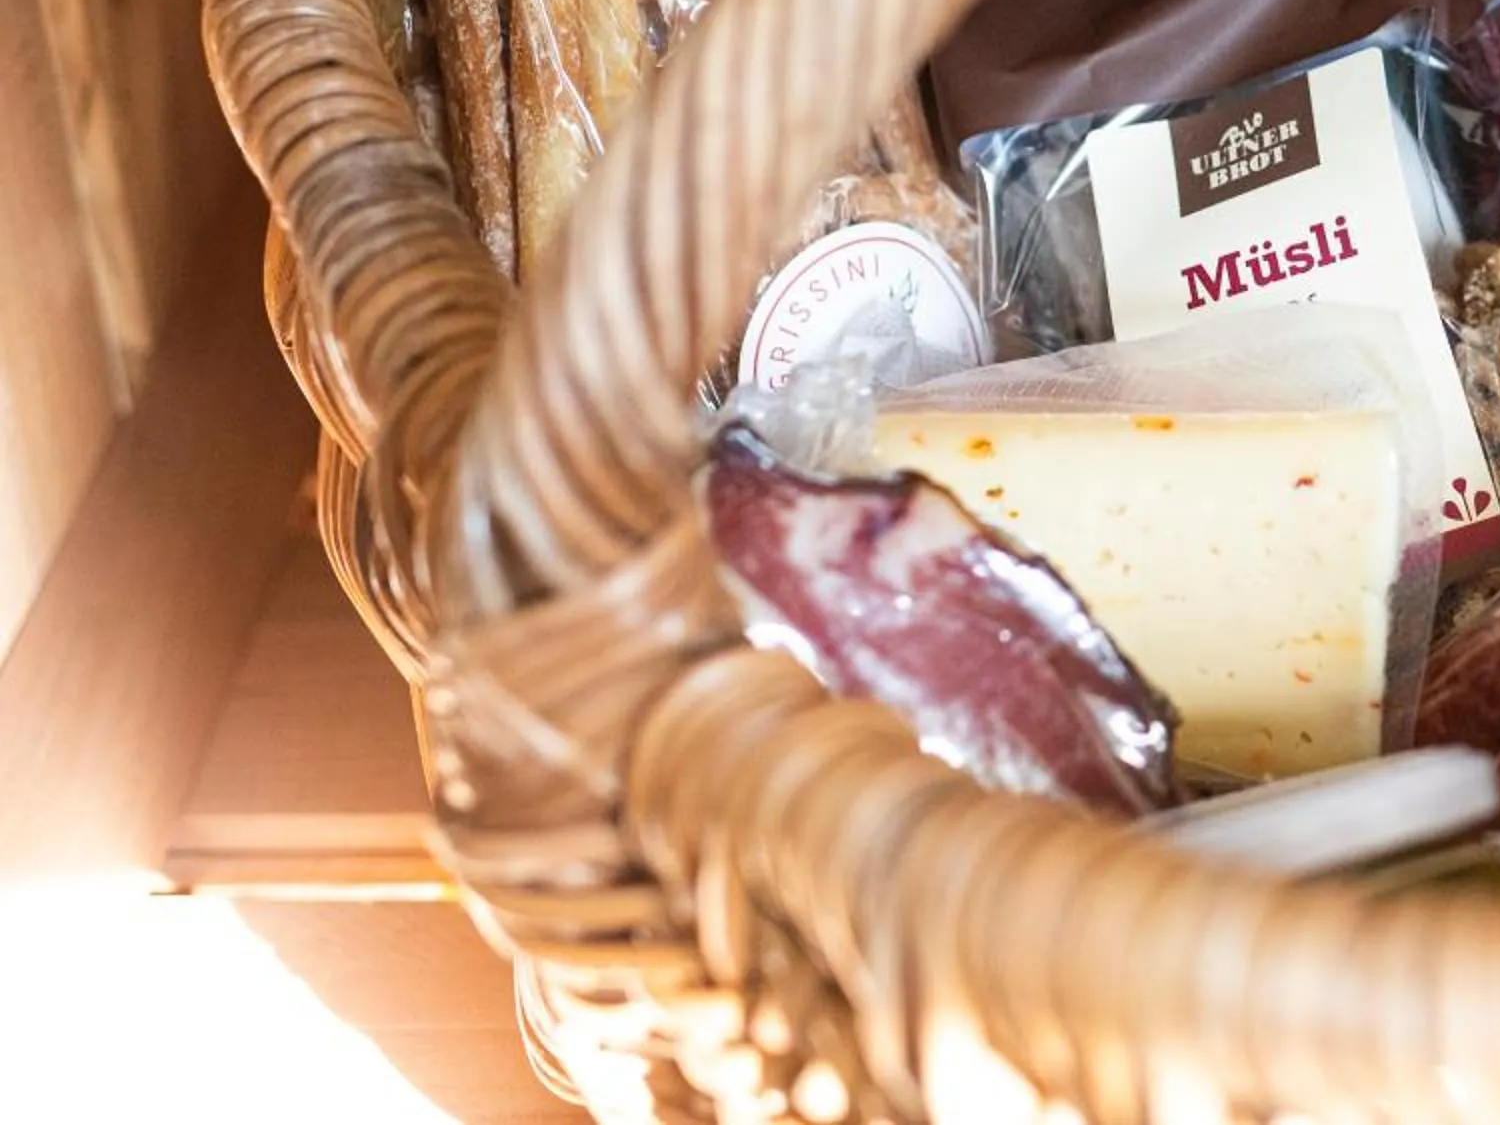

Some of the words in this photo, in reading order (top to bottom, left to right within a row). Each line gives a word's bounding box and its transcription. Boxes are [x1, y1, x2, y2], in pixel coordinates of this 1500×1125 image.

[1190, 119, 1300, 175] ULTNER
[1209, 144, 1287, 190] BROT
[1180, 215, 1359, 310] Müsli
